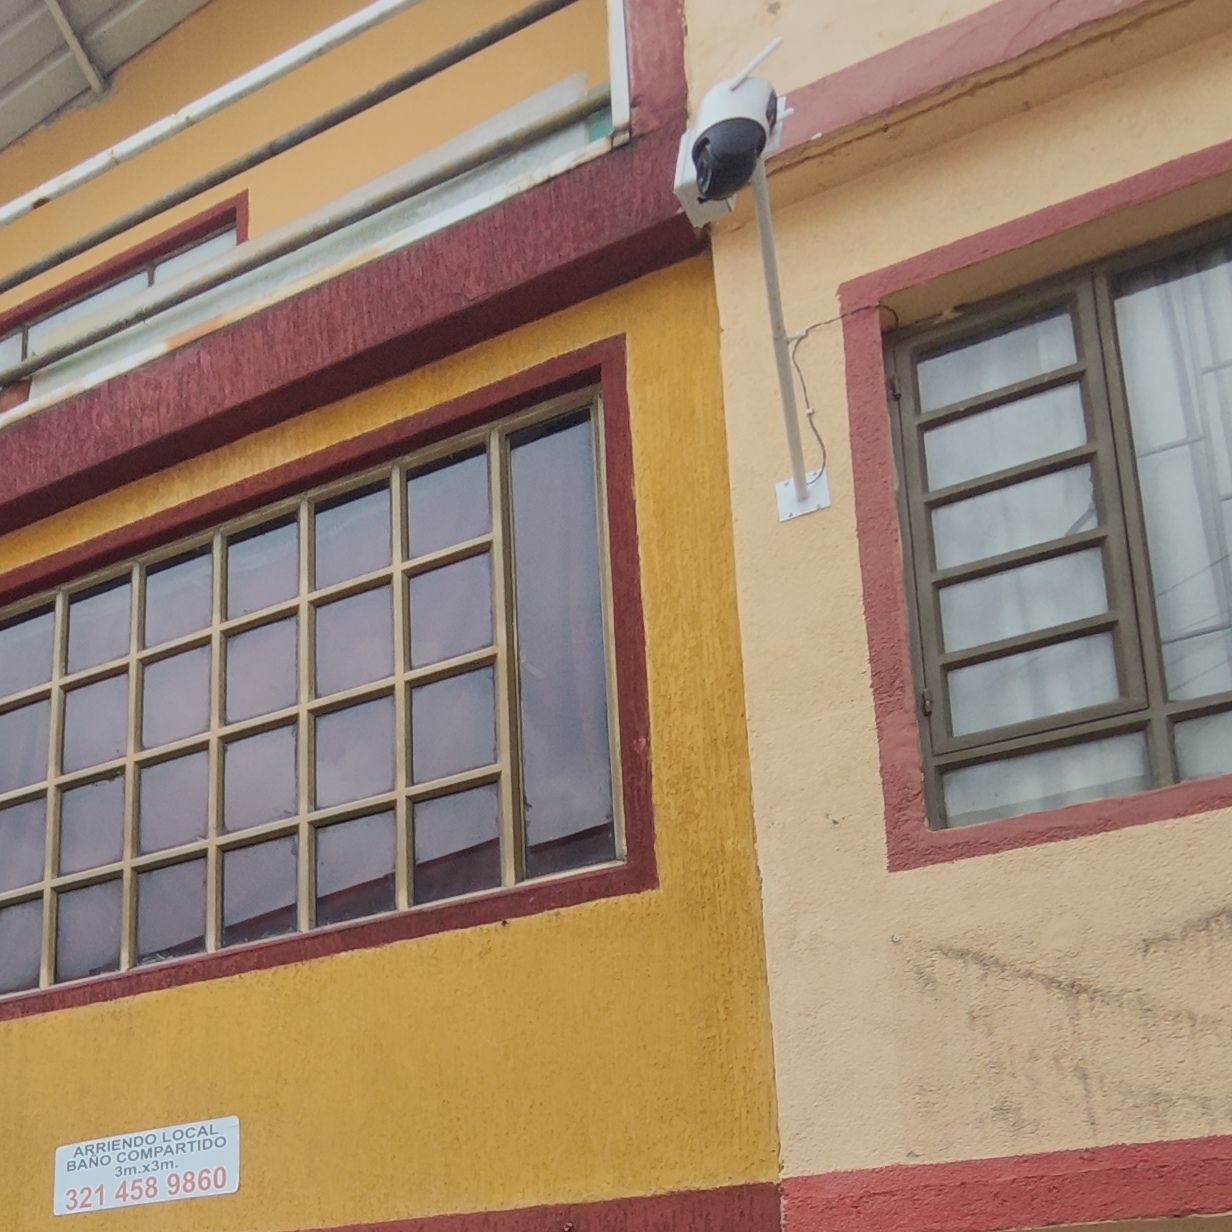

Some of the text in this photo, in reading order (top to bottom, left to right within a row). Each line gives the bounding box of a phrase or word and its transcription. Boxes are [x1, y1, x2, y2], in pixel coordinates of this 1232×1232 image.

[73, 1124, 219, 1158] ARRIENDO LOCAL
[116, 1136, 227, 1164] COMPARTIDO
[65, 1166, 227, 1211] 321 458 9860
